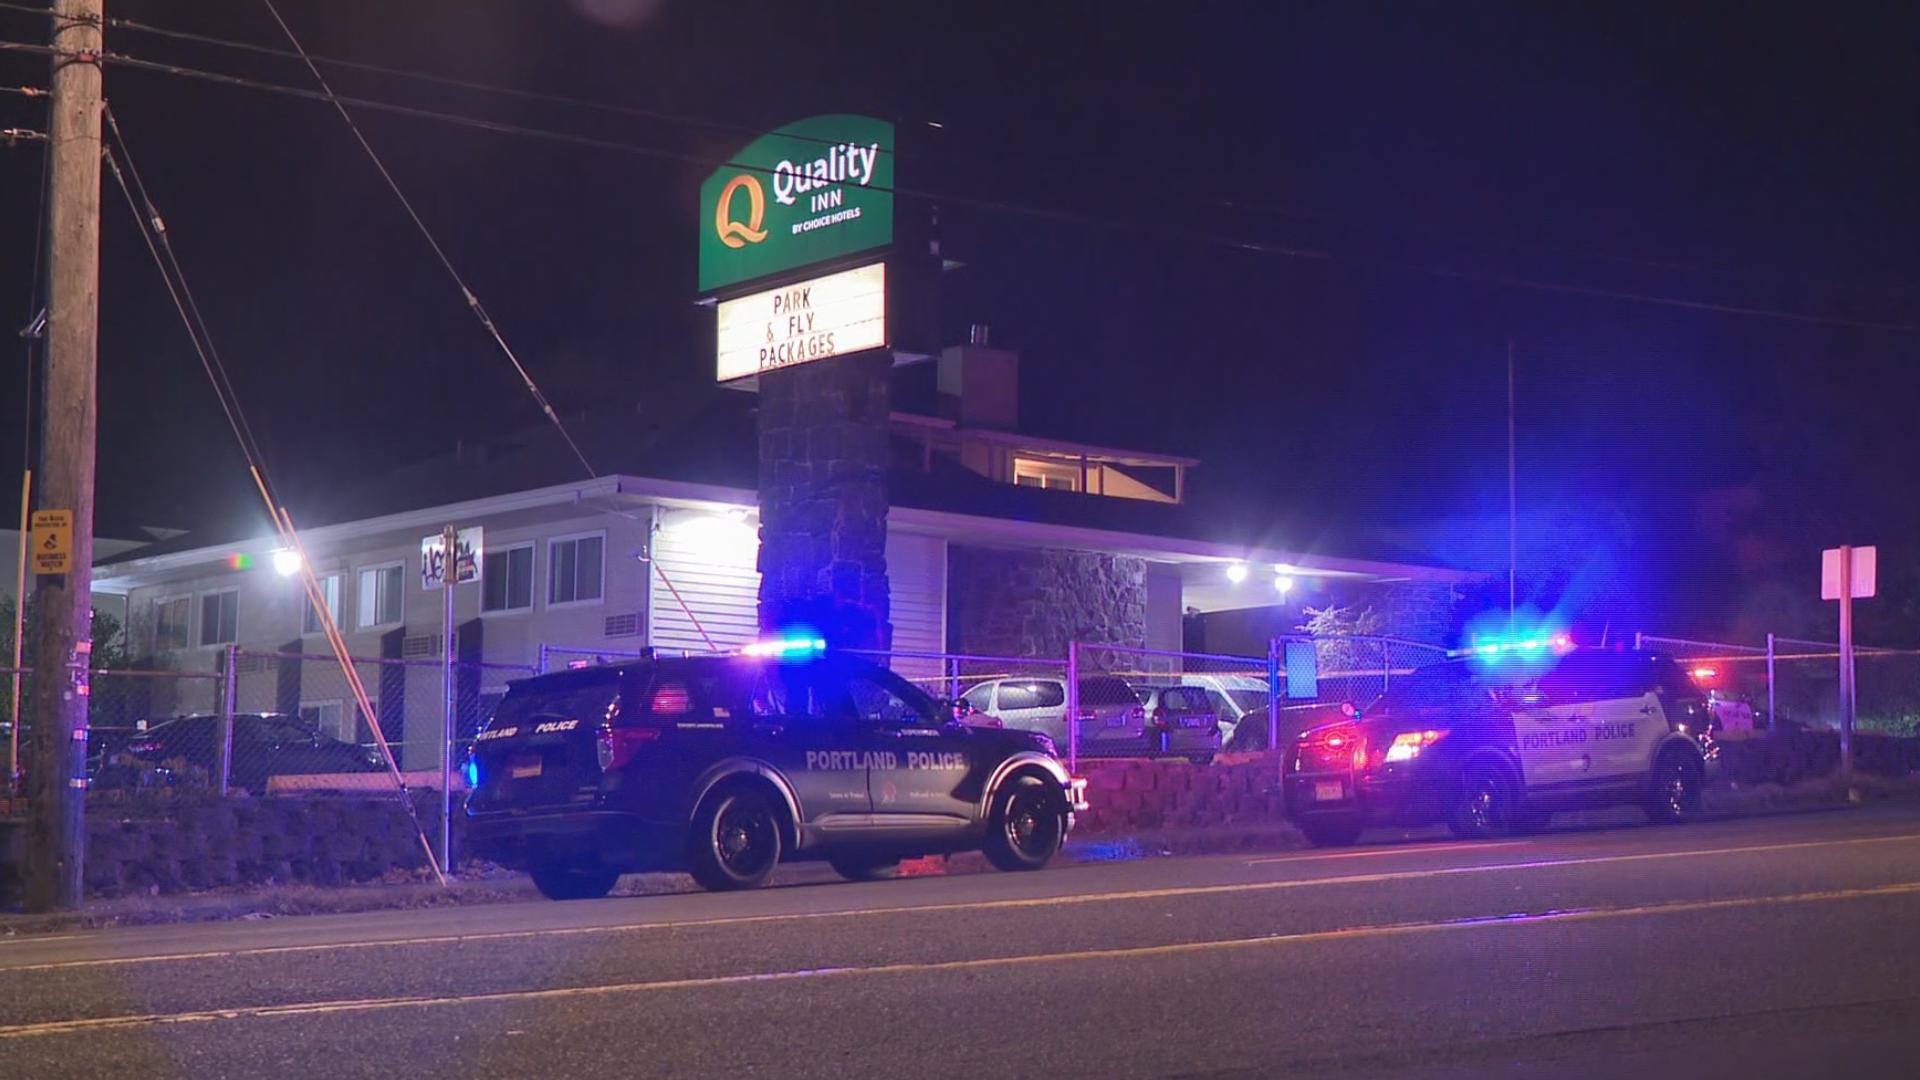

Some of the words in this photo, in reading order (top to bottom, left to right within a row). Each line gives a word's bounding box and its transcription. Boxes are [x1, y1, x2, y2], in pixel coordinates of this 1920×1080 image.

[773, 142, 878, 205] Quality
[715, 174, 768, 248] Q
[811, 188, 842, 213] INN
[792, 223, 803, 234] BY
[803, 214, 831, 232] CHOICE
[831, 207, 861, 224] HOTELS
[774, 287, 811, 315] PARK
[766, 321, 774, 343] &
[789, 311, 814, 338] FLY
[760, 331, 835, 369] PACKAGES
[535, 719, 579, 734] POLICE
[1523, 729, 1587, 750] PORTLAND
[1595, 723, 1635, 740] POLICE
[806, 750, 897, 770] PORTLAND
[907, 751, 965, 770] POLICE
